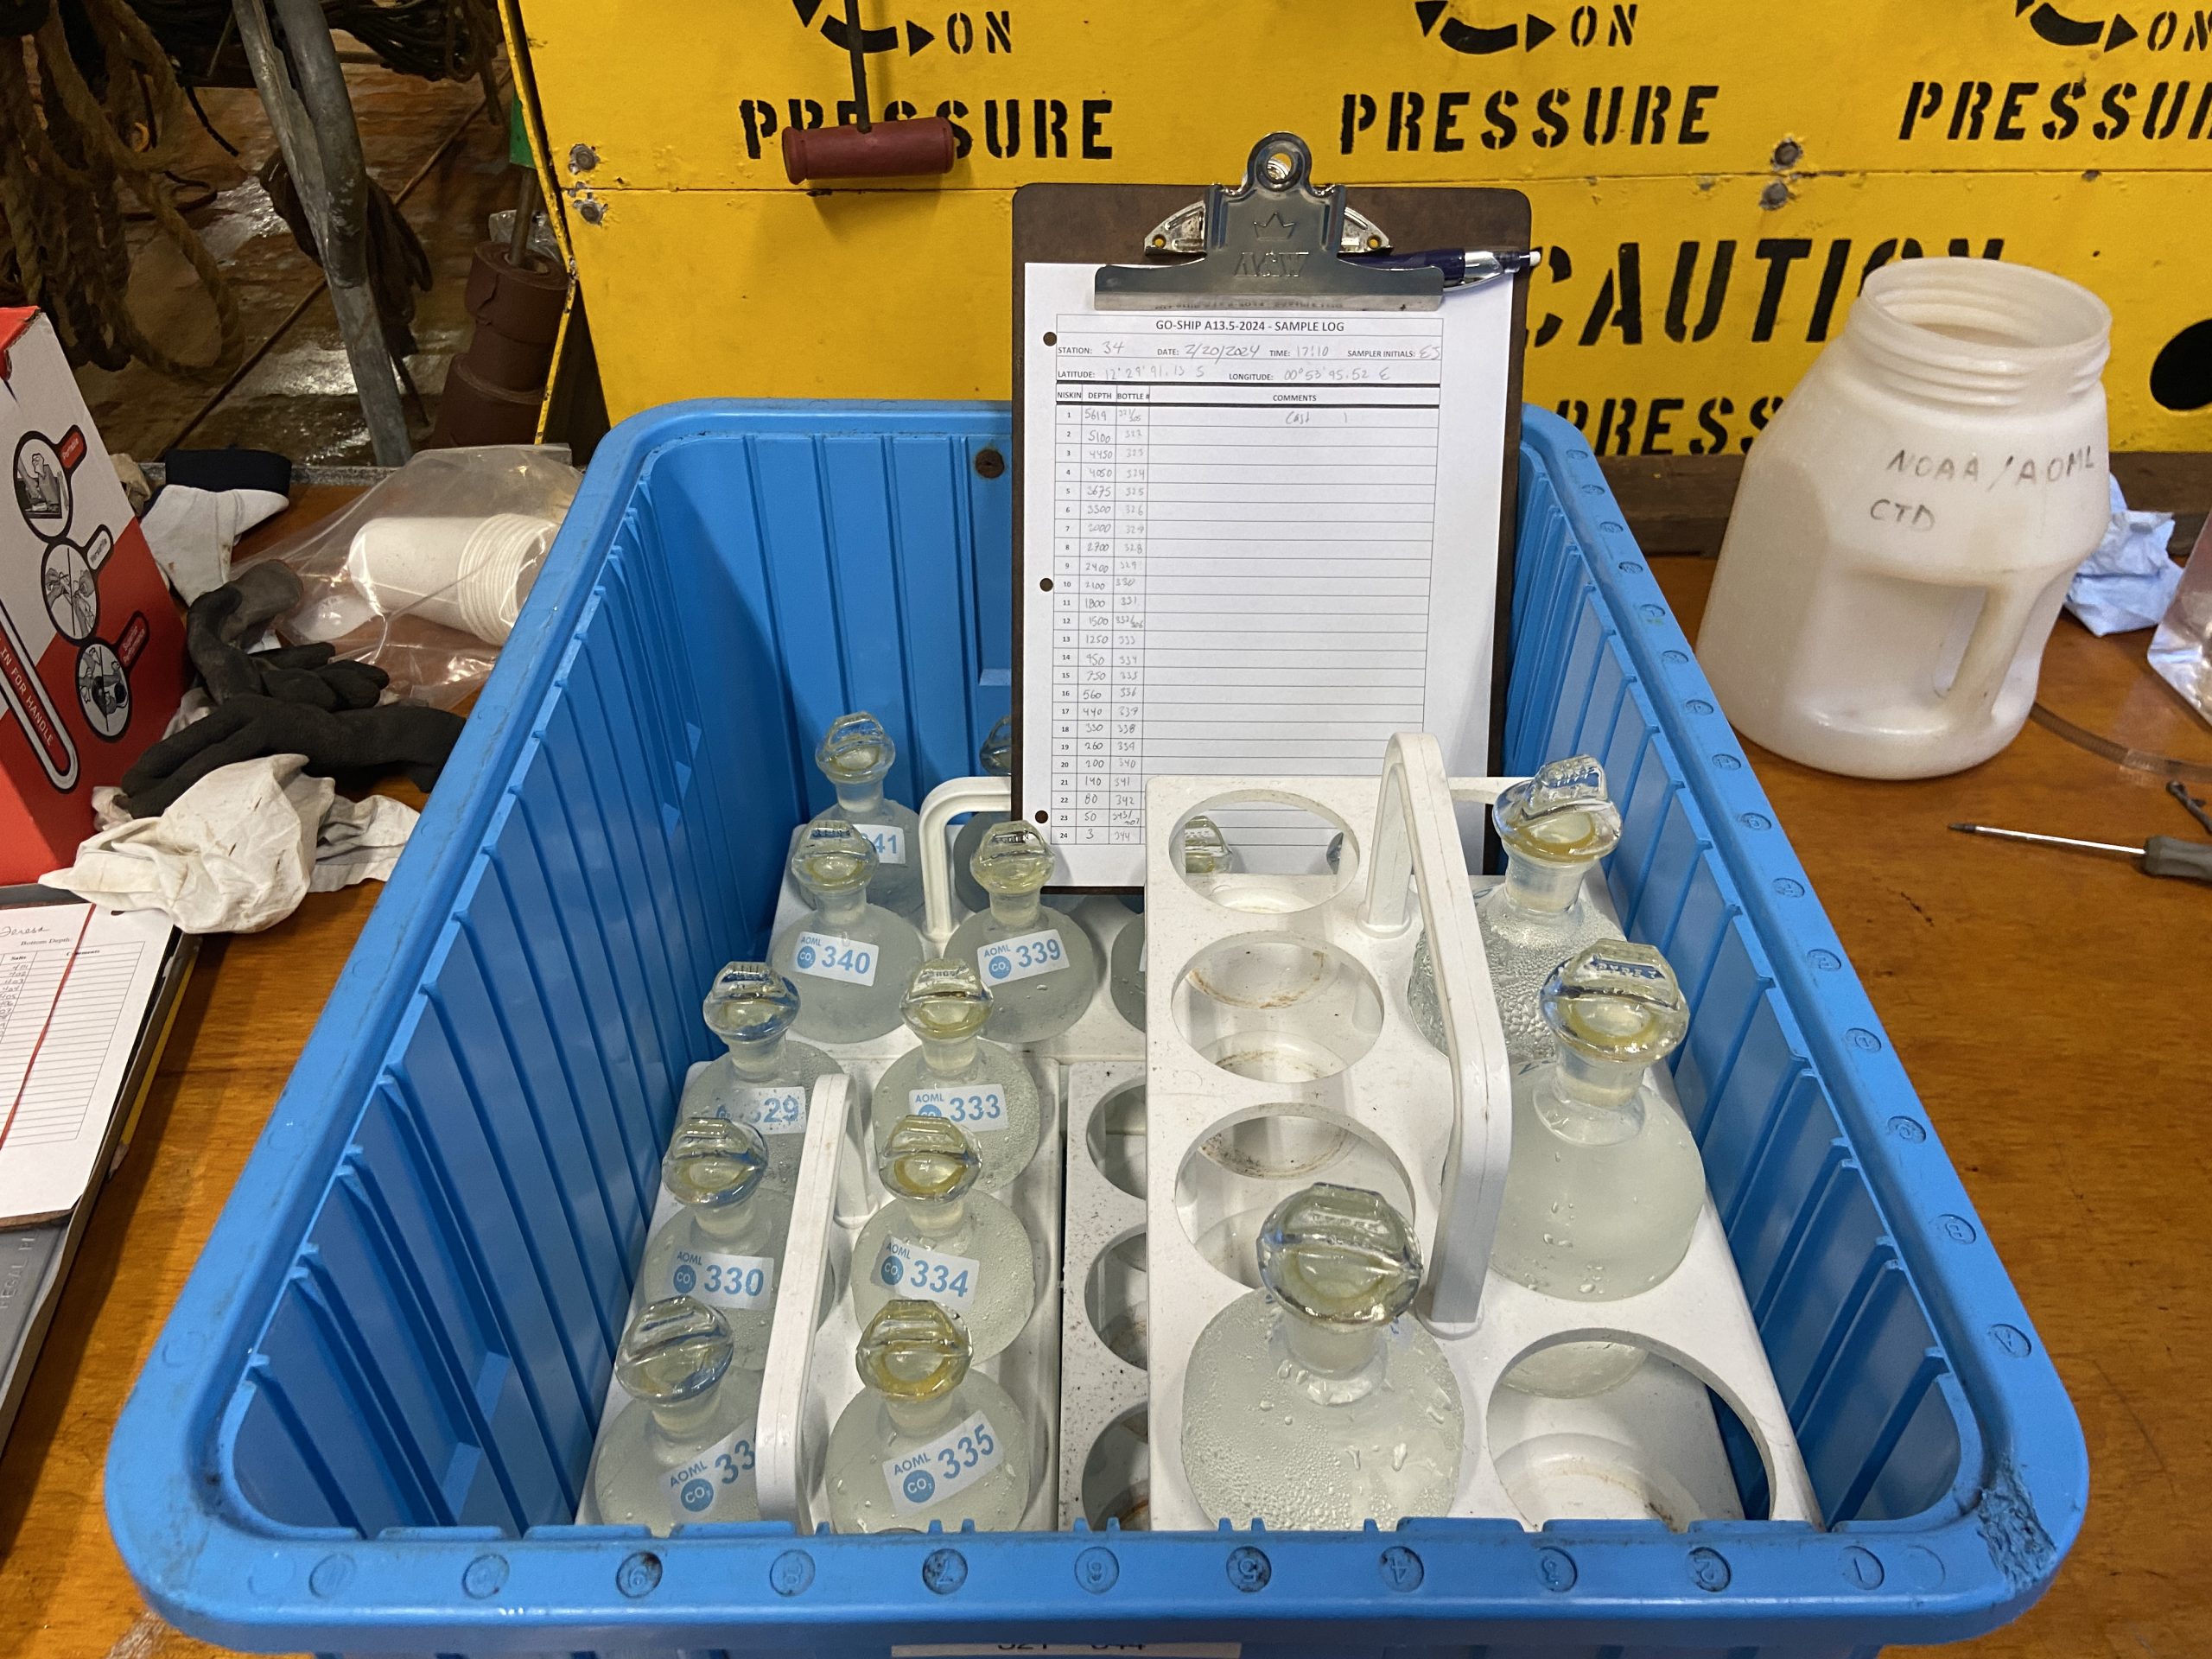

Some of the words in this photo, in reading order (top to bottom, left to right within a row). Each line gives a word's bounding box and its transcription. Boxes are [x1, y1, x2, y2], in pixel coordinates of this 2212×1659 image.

[947, 10, 1012, 54] ON
[1570, 3, 1637, 48] ON
[2147, 10, 2212, 52] ON
[1340, 86, 1719, 155] PRESSURE
[1526, 238, 2004, 347] CAUTI
[1155, 321, 1202, 330] GO-SHIP
[1205, 321, 1265, 331] A13.5-2024
[1274, 321, 1319, 332] SAMPLE
[1321, 321, 1344, 332] LOG
[1102, 341, 1125, 355] 34
[1086, 634, 1109, 644] 1250
[1083, 690, 1102, 700] 560
[10, 666, 27, 696] FOR
[26, 695, 54, 746] HANDLE
[1083, 708, 1102, 716] 440
[1085, 776, 1102, 786] 140
[1084, 793, 1098, 804] 80
[1116, 794, 1135, 806] 342
[1084, 810, 1096, 821] 50
[1086, 828, 1094, 839] 3
[800, 936, 822, 947] AOML
[983, 944, 1011, 957] AOML
[821, 945, 871, 975] 340
[1015, 938, 1061, 968] 339
[915, 1093, 944, 1103] AOML
[950, 1094, 1001, 1122] 333
[677, 1251, 702, 1266] AOML
[886, 1243, 911, 1260] AOML
[704, 1264, 764, 1296] 330
[911, 1260, 969, 1297] 334
[938, 1423, 994, 1479] 335
[715, 1439, 756, 1484] 33
[893, 1452, 931, 1476] AOML
[670, 1460, 709, 1487] AOML
